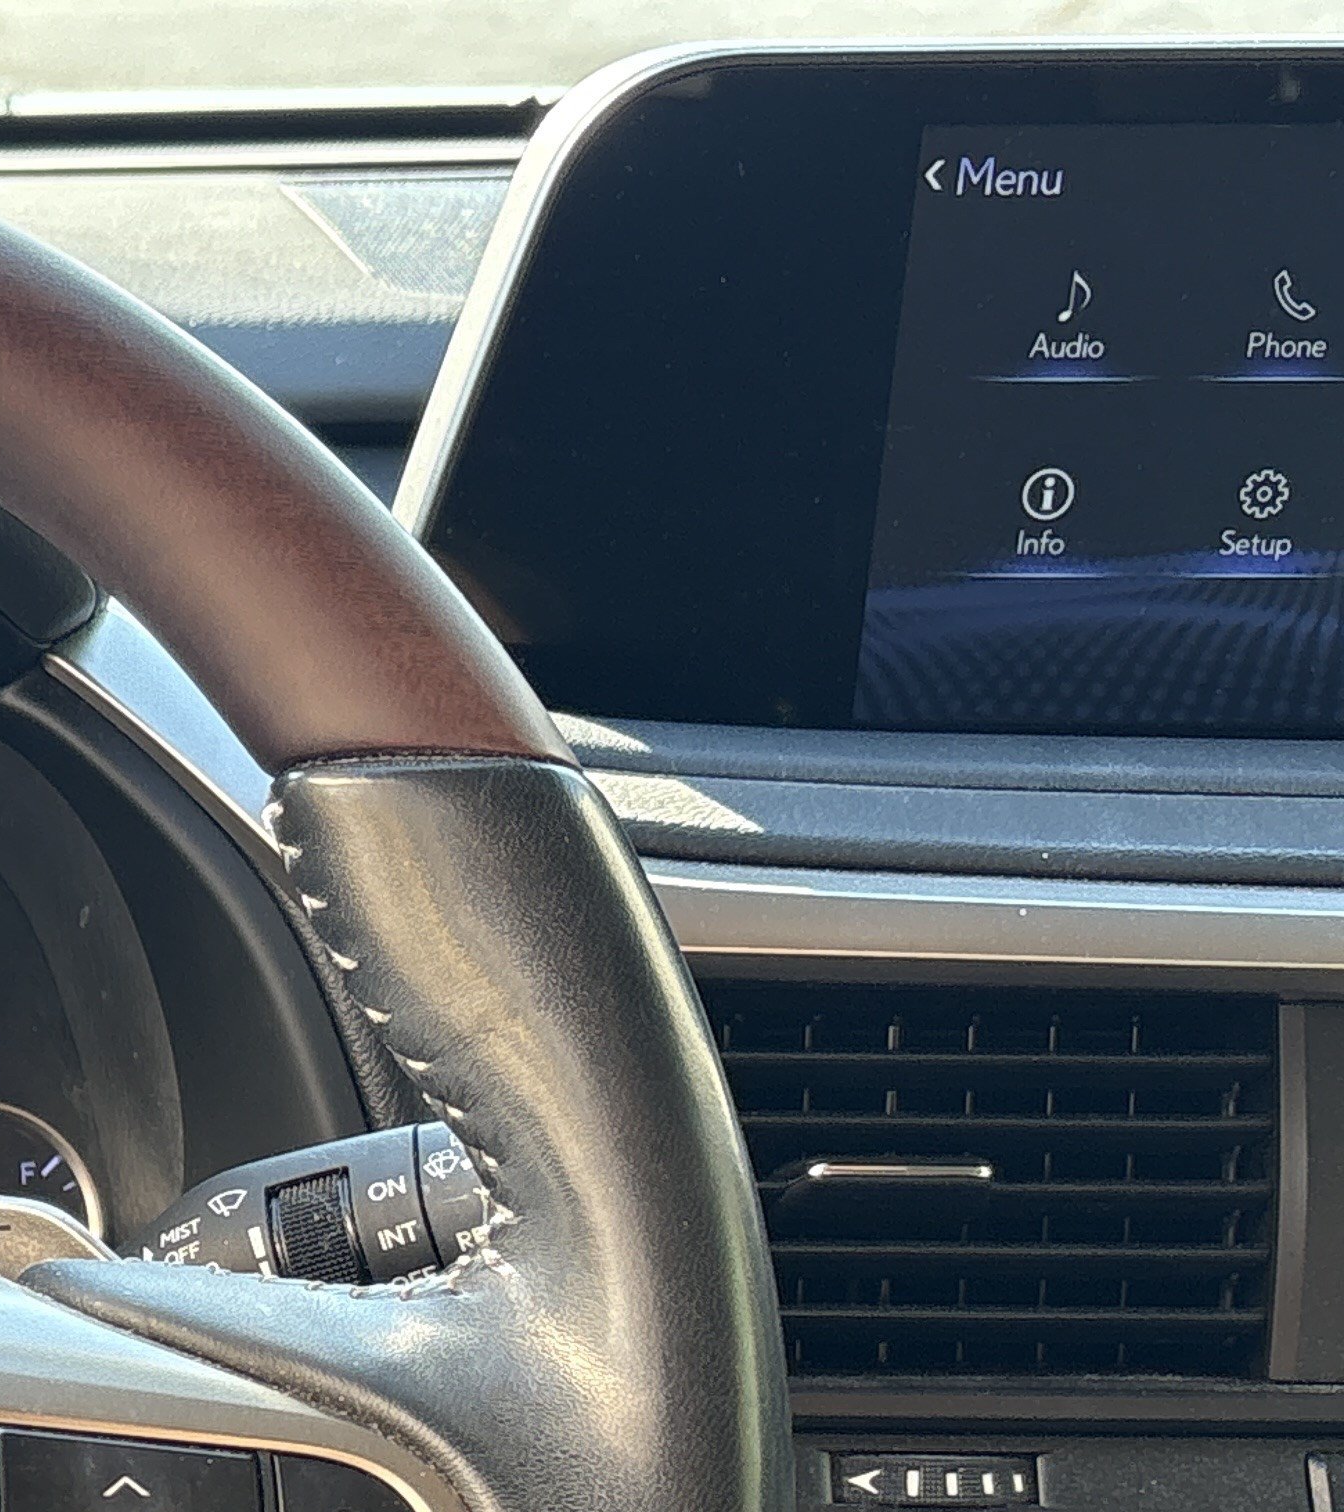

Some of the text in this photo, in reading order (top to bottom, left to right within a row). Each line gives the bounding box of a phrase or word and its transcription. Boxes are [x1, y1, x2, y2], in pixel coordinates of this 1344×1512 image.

[955, 156, 1063, 197] Menu
[1027, 332, 1106, 361] Audio
[1246, 332, 1328, 361] Phone
[1015, 531, 1066, 556] Info
[1218, 531, 1293, 562] Setup
[20, 1161, 36, 1187] F
[367, 1175, 408, 1201] ON
[159, 1217, 201, 1249] MIST
[376, 1220, 418, 1251] INT
[164, 1240, 201, 1265] OFF
